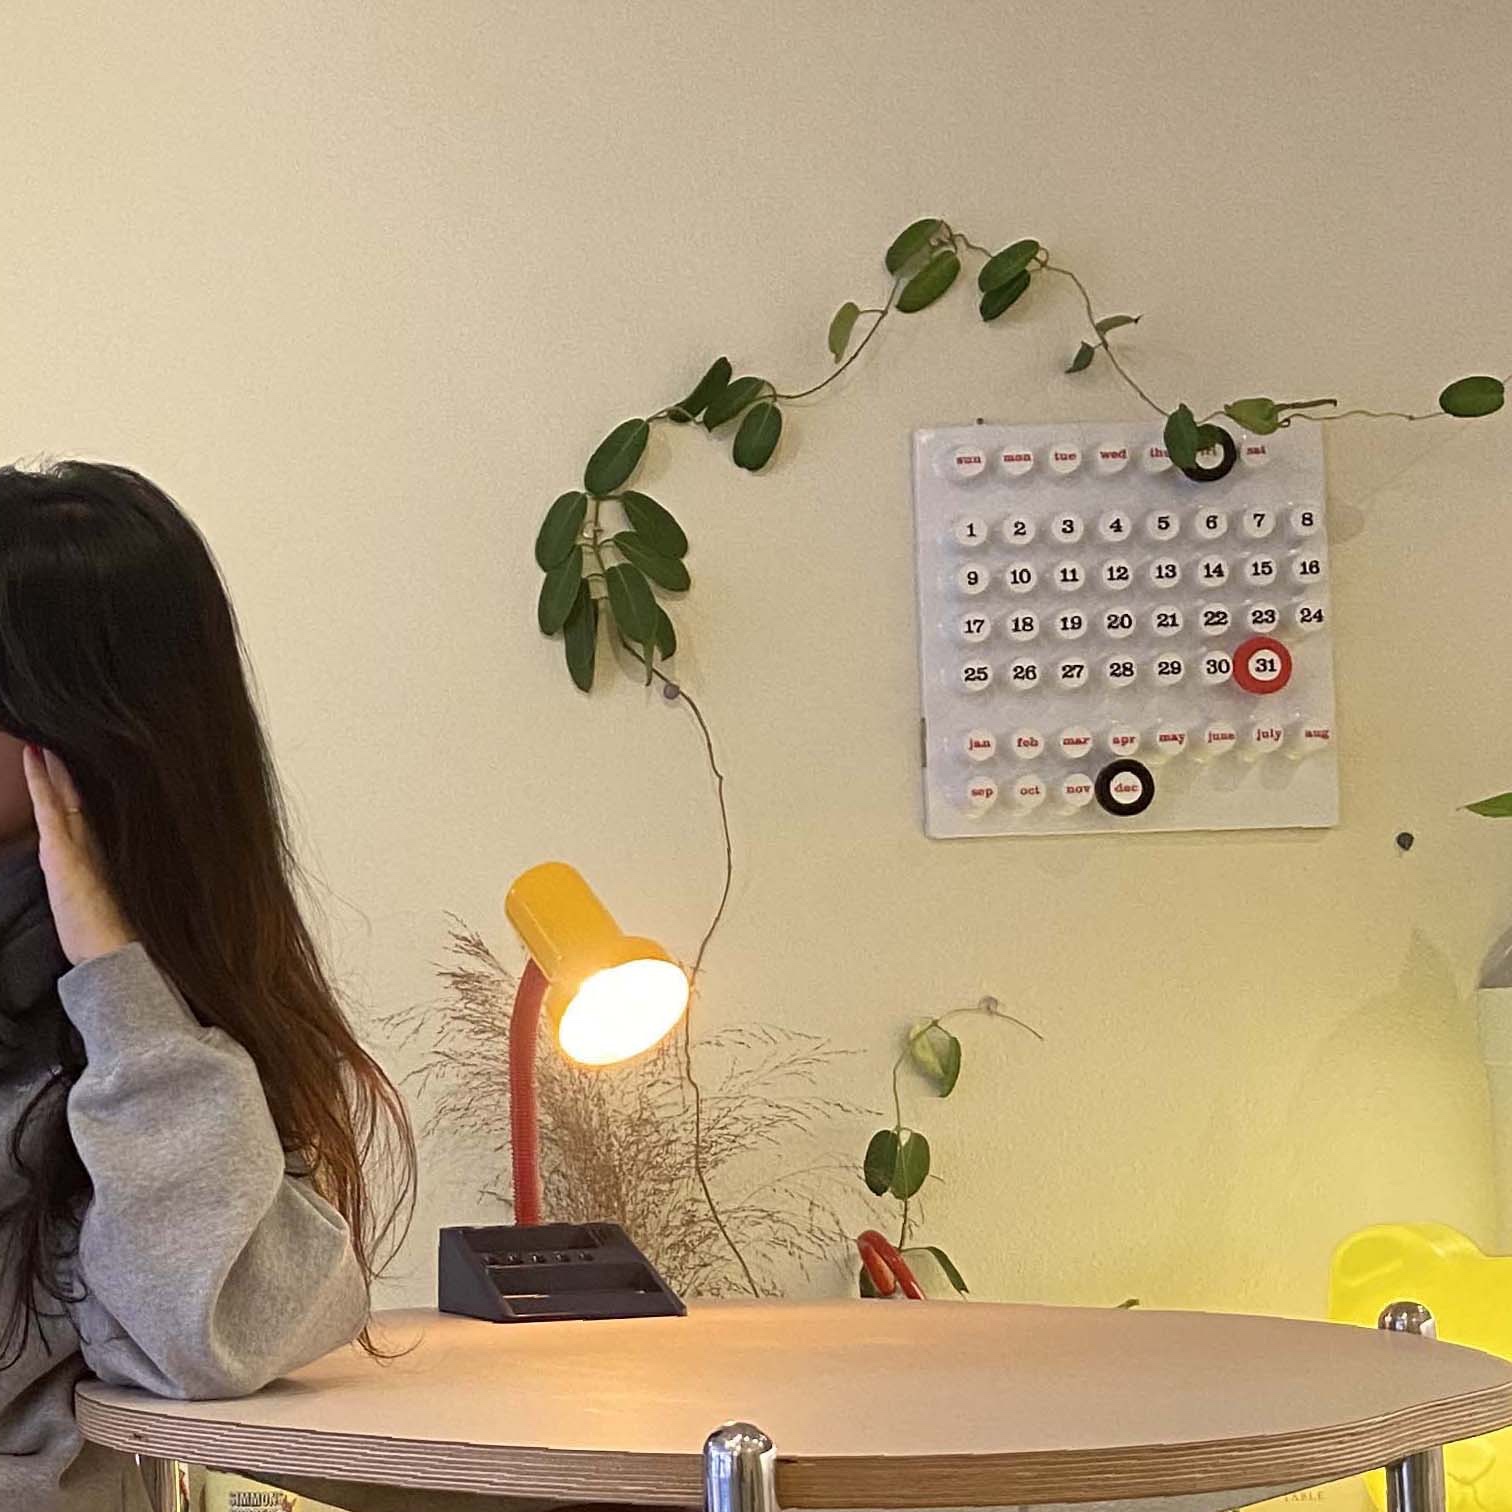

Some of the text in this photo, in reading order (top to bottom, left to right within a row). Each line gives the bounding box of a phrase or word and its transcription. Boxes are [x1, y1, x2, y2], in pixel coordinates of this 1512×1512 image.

[956, 456, 981, 464] sun
[1003, 453, 1031, 462] mon
[1054, 451, 1077, 461] tue
[1100, 449, 1127, 459] wed
[967, 512, 1314, 537] 1 2 3 4 5 6 7 8
[967, 559, 1321, 586] 9 10 11 12 13 14 15 16
[964, 607, 1324, 634] 17 18 19 20 21 22 23 24
[964, 658, 1277, 682] 25 26 27 28 29 30 31
[968, 728, 1330, 750] jan feb mar apr may june july aug
[971, 782, 1138, 799] sep oct nov dec
